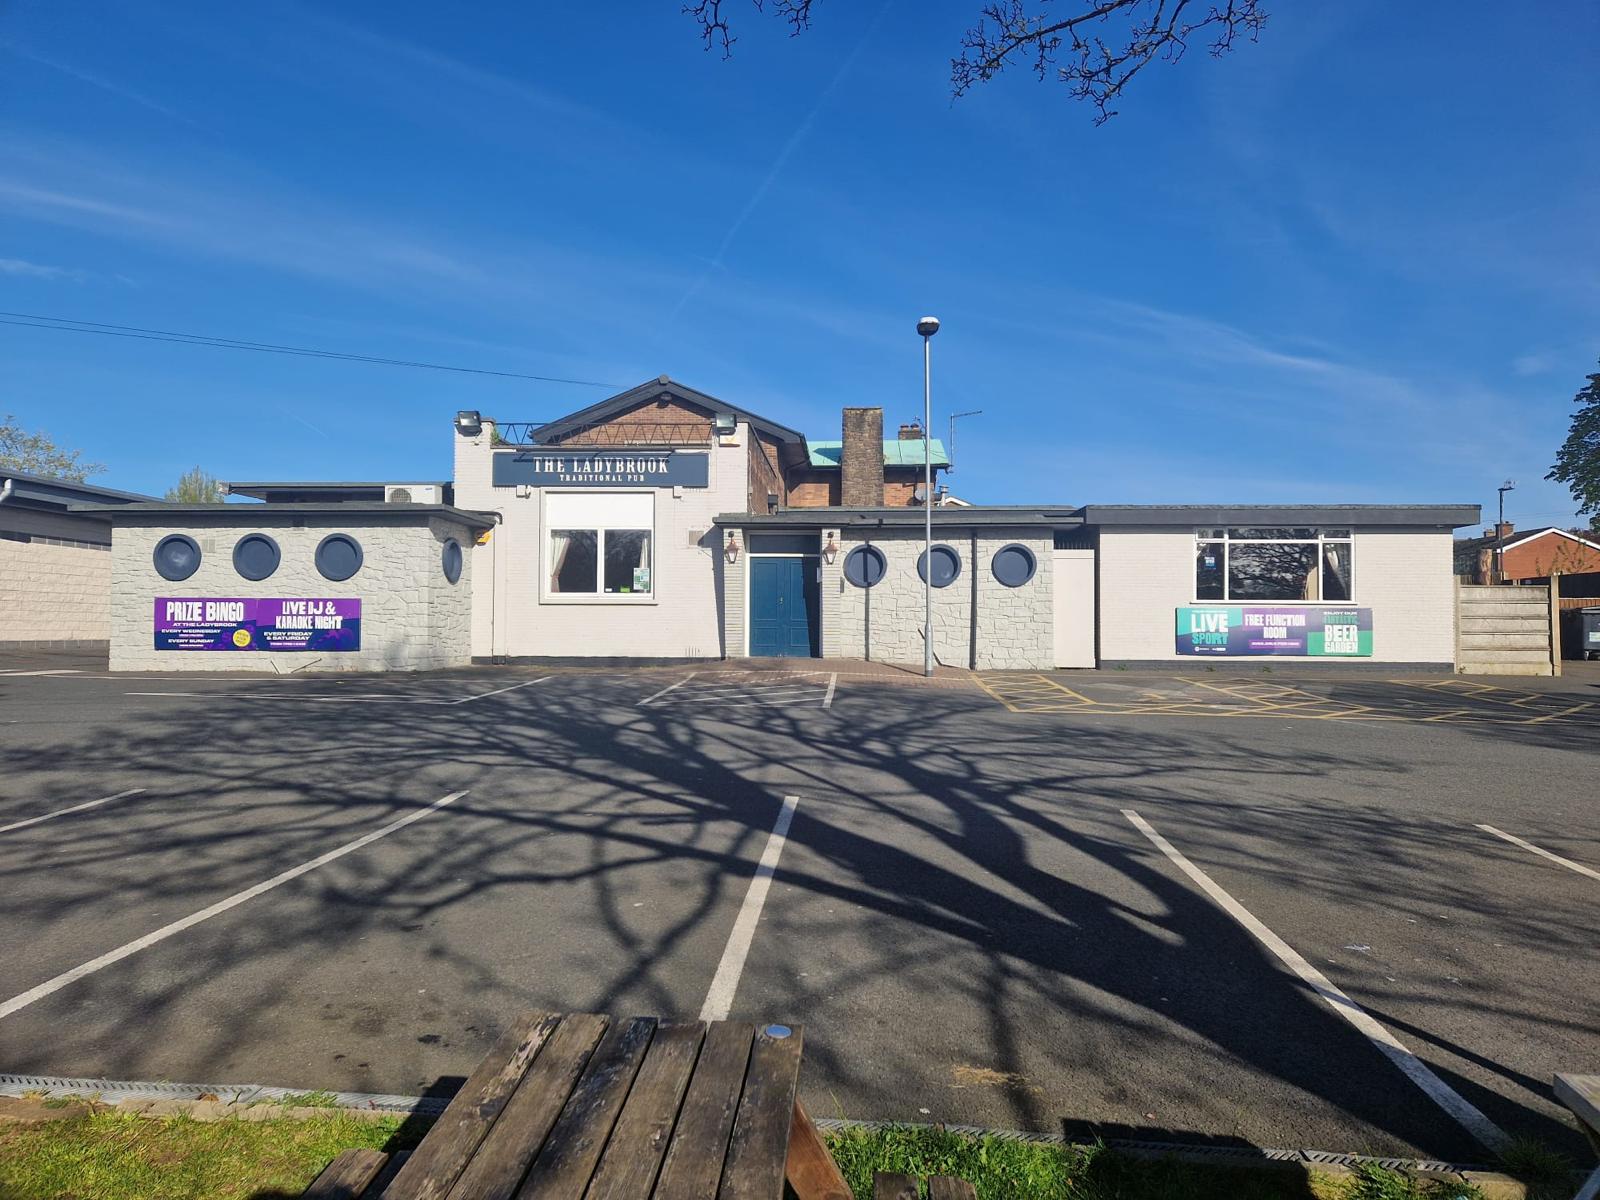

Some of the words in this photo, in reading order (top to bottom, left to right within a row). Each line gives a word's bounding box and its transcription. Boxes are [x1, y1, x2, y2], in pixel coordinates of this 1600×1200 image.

[533, 457, 565, 473] THE
[573, 457, 669, 474] LADYBROOK
[560, 474, 622, 482] TRADITIONAL
[627, 474, 645, 482] PUB
[166, 601, 203, 622] PRIZE
[205, 601, 244, 622] BINGO
[282, 601, 306, 615] LIVE
[308, 601, 323, 615] DJ
[325, 601, 336, 615] &
[275, 615, 313, 629] KARAOKE
[315, 615, 343, 629] NIGHT
[1191, 613, 1228, 632] LIVE
[1245, 614, 1264, 626] FREE
[1265, 614, 1306, 627] FUNCTION
[1191, 632, 1229, 645] SPORT
[1263, 626, 1287, 638] ROOM
[1324, 624, 1358, 642] BEER
[1324, 642, 1358, 653] GARDEN
